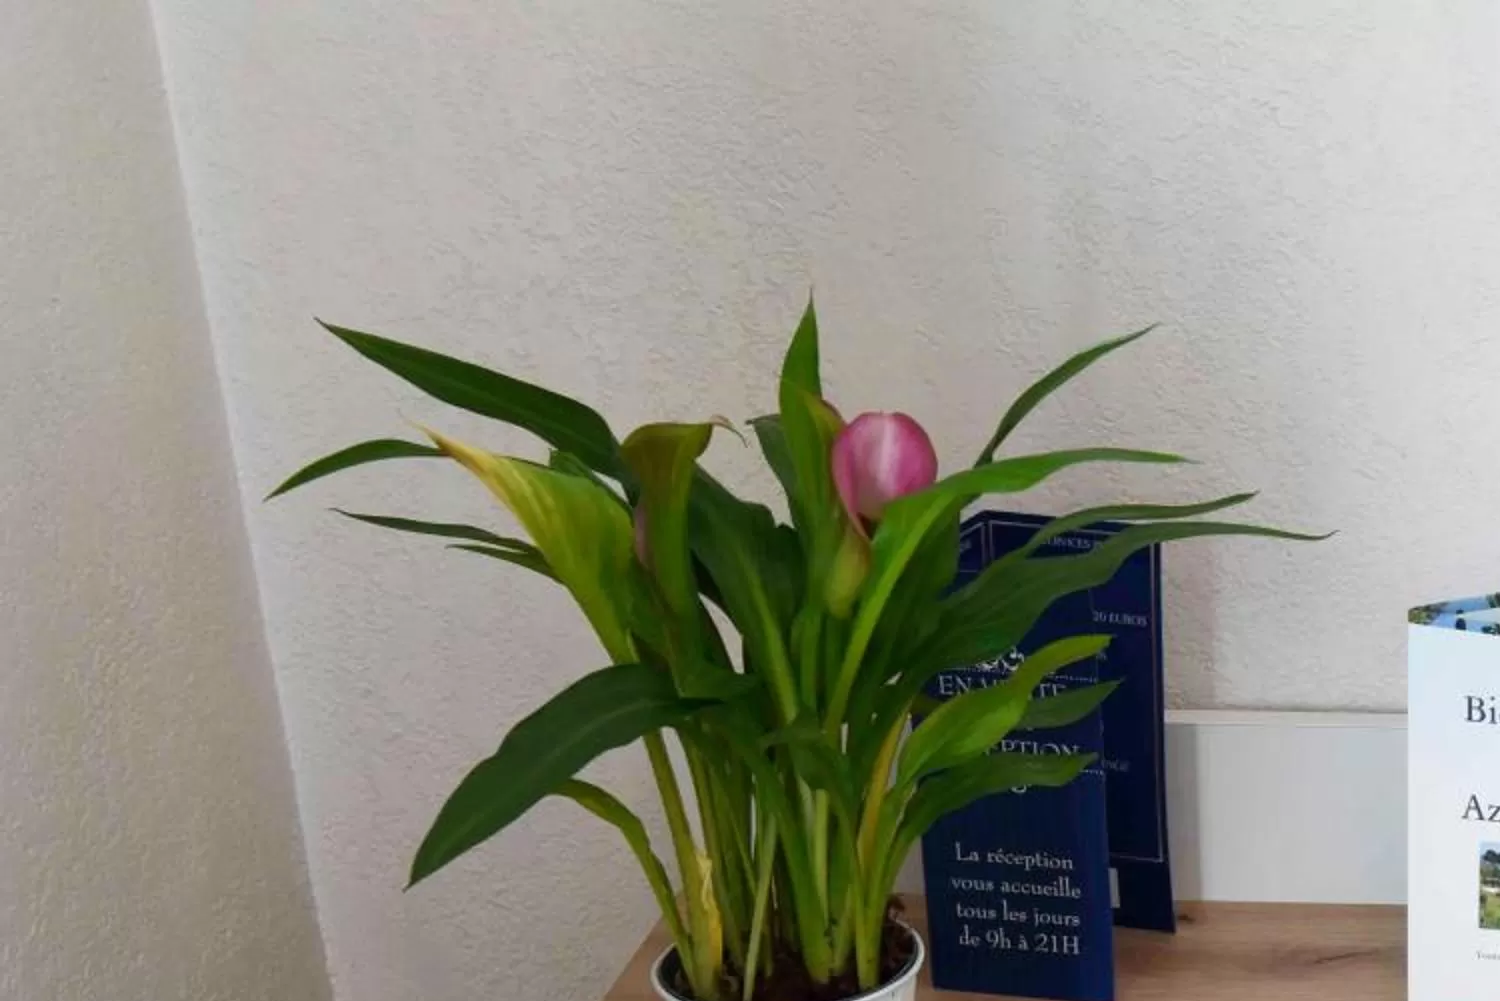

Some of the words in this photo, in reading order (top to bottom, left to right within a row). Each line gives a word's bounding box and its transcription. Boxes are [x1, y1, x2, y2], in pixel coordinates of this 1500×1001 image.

[1108, 612, 1147, 628] EUROS
[938, 674, 972, 697] EN
[955, 842, 980, 862] La
[986, 848, 1073, 871] réception
[951, 878, 994, 893] vous
[1000, 876, 1081, 899] accueille
[956, 902, 997, 921] tous
[1003, 900, 1026, 922] les
[1034, 907, 1080, 927] jours
[959, 924, 980, 947] de
[985, 928, 1012, 950] 9h
[1017, 932, 1029, 951] à
[1034, 934, 1080, 955] 21H
